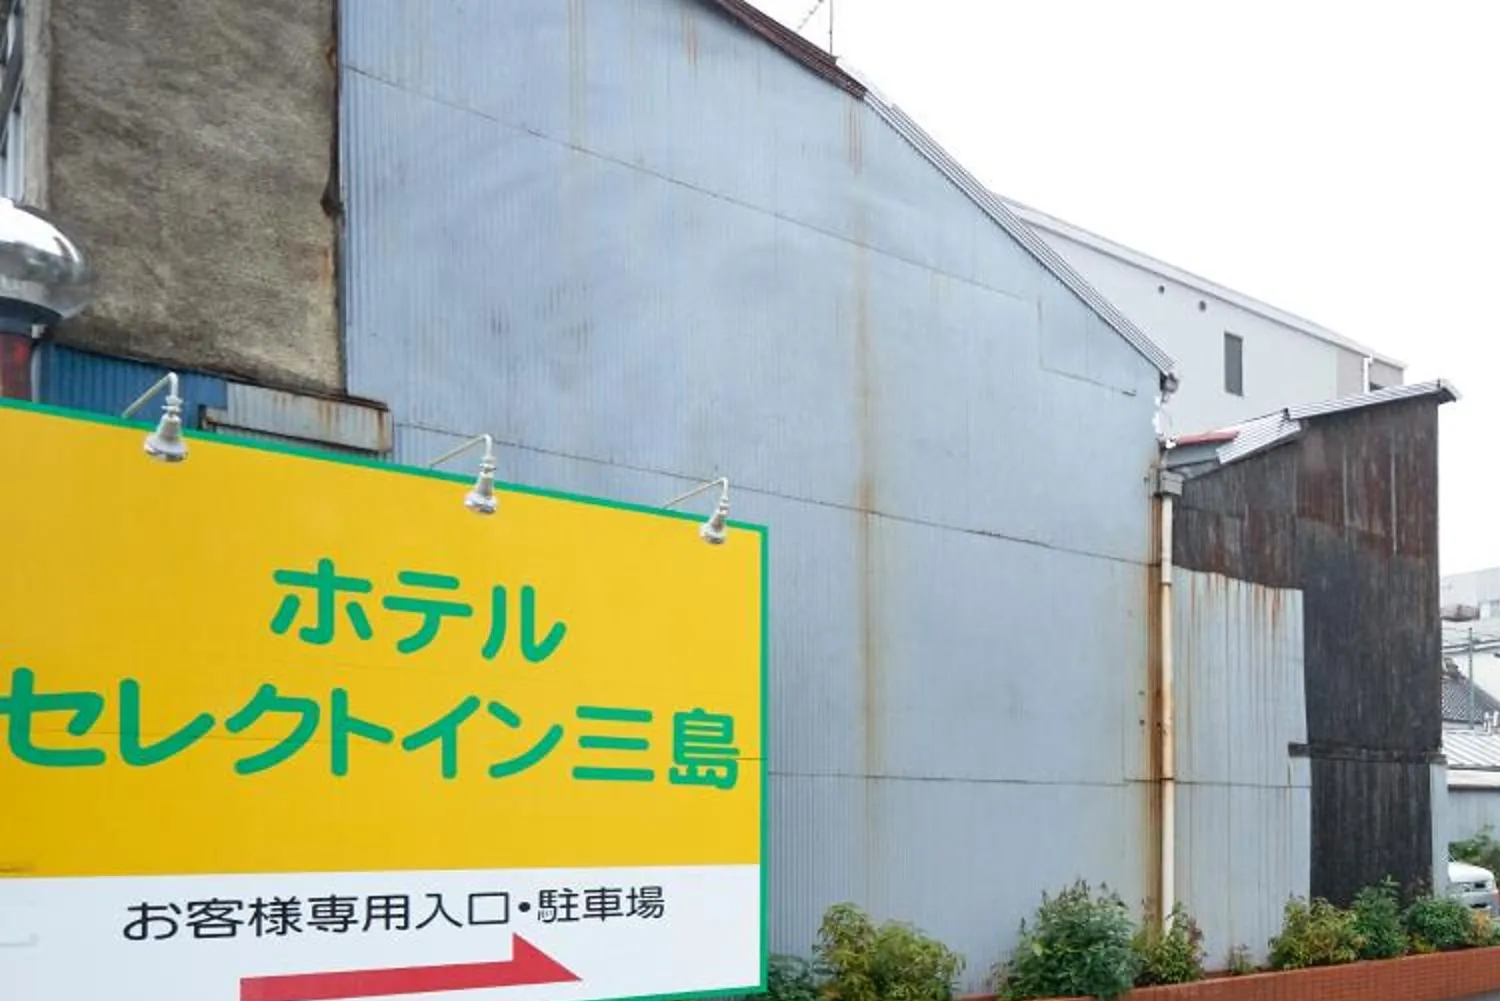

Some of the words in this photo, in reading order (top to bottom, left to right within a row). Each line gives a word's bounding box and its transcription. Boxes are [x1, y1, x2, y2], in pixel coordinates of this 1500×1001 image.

[271, 559, 566, 662] ホテル
[0, 667, 739, 789] セレクトイン三島
